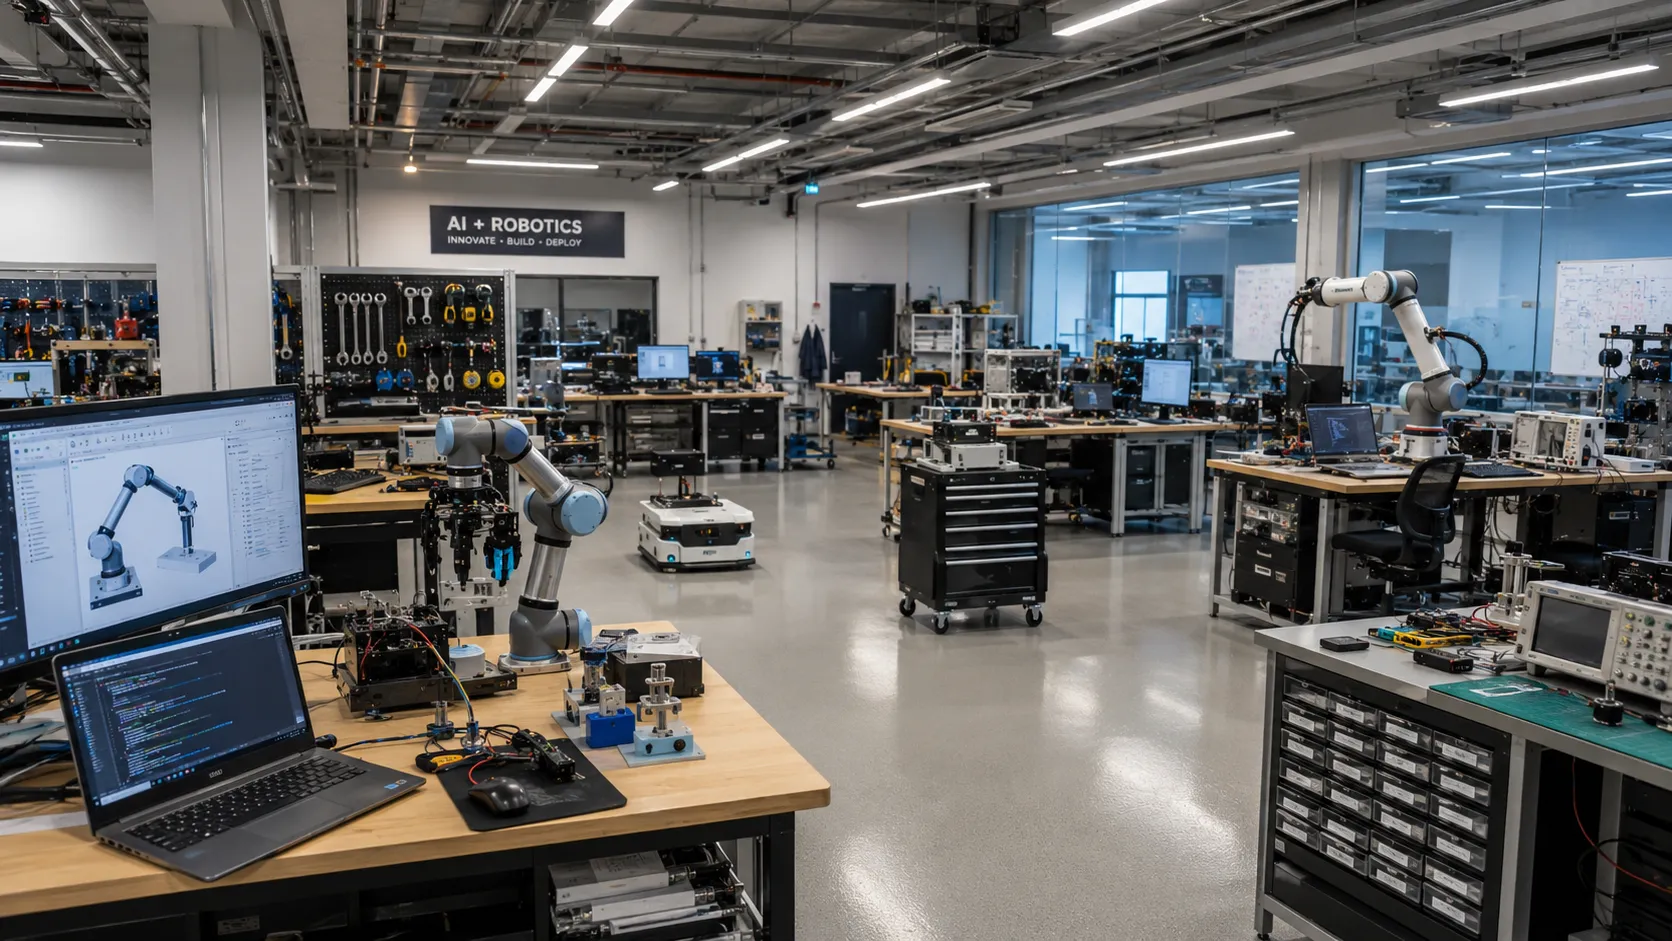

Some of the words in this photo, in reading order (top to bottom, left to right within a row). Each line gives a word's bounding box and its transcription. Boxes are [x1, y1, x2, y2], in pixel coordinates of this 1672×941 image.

[447, 215, 466, 231] AI
[473, 219, 485, 230] +
[491, 216, 582, 234] ROBOTICS
[447, 235, 496, 245] INNOVATE
[507, 237, 535, 246] BUILD
[545, 238, 582, 247] DEPLOY
